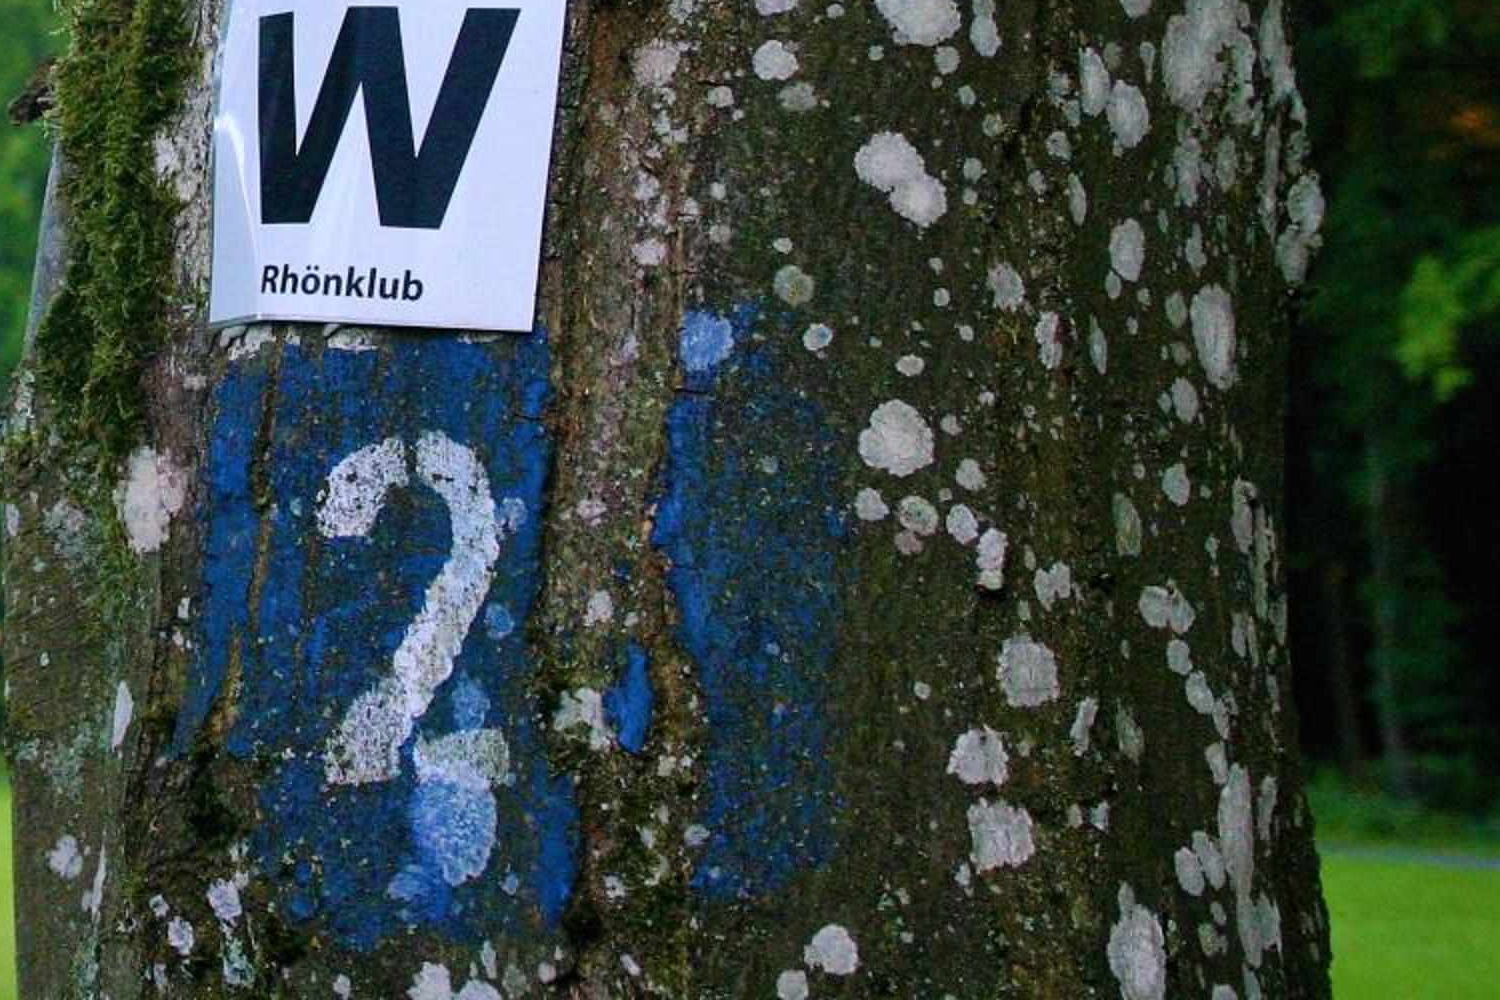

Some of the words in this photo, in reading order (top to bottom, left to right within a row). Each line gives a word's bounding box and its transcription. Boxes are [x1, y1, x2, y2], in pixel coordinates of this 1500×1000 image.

[258, 6, 520, 229] W
[260, 264, 424, 301] Rhönklub
[315, 429, 510, 787] 2
